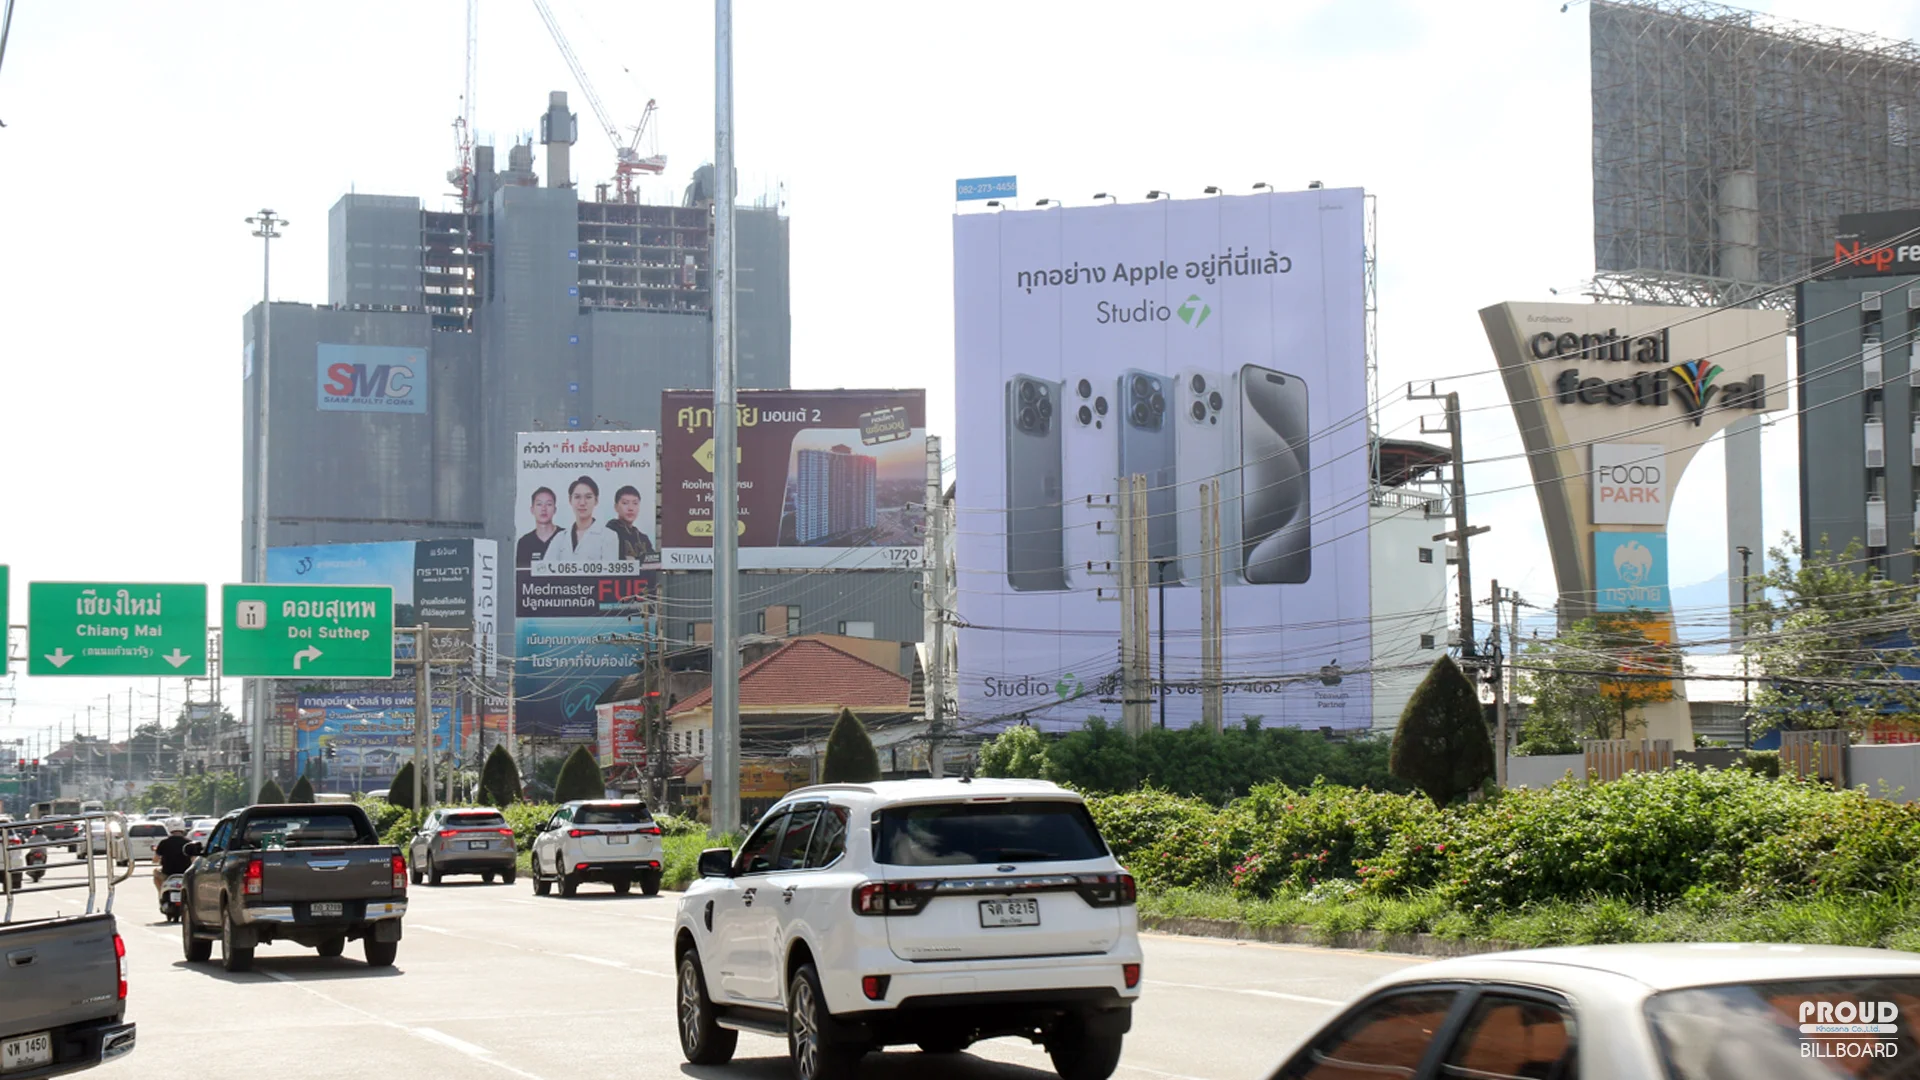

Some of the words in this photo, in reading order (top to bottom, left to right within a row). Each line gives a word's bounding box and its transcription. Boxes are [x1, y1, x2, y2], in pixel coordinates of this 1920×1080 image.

[1017, 262, 1106, 293] ทุกอย่าง
[1113, 260, 1178, 286] Apple
[1185, 246, 1292, 285] อยู่ที่นี่แล้ว
[1096, 300, 1171, 325] Studio
[1531, 328, 1670, 363] central
[323, 362, 415, 398] SMC
[324, 396, 349, 404] SIAM
[351, 397, 384, 405] MULTI
[386, 398, 415, 406] CONS
[1556, 359, 1766, 427] festival
[762, 408, 807, 422] มอนเต้
[812, 409, 822, 422] 2
[523, 442, 550, 454] คำว่า
[578, 438, 640, 456] เรื่องปลูกผม
[1600, 466, 1661, 484] FOOD
[1601, 487, 1660, 503] PARK
[889, 549, 918, 560] 1720
[558, 562, 634, 574] 065-009-3995
[522, 583, 595, 596] Medmaster
[598, 579, 649, 602] FUE
[76, 589, 162, 616] เชียงใหม่
[522, 597, 595, 611] ปลูกผมเทคนิค
[247, 613, 256, 625] 11
[282, 600, 376, 624] ดอยสุเทพ
[76, 624, 129, 640] Chiang
[135, 624, 162, 636] Mai
[288, 626, 312, 639] Doi
[319, 626, 370, 641] Suthep
[984, 676, 1049, 698] Studio
[382, 698, 392, 706] 16
[1317, 701, 1347, 709] Partner
[1008, 902, 1035, 915] 6215
[25, 1037, 47, 1053] 1450
